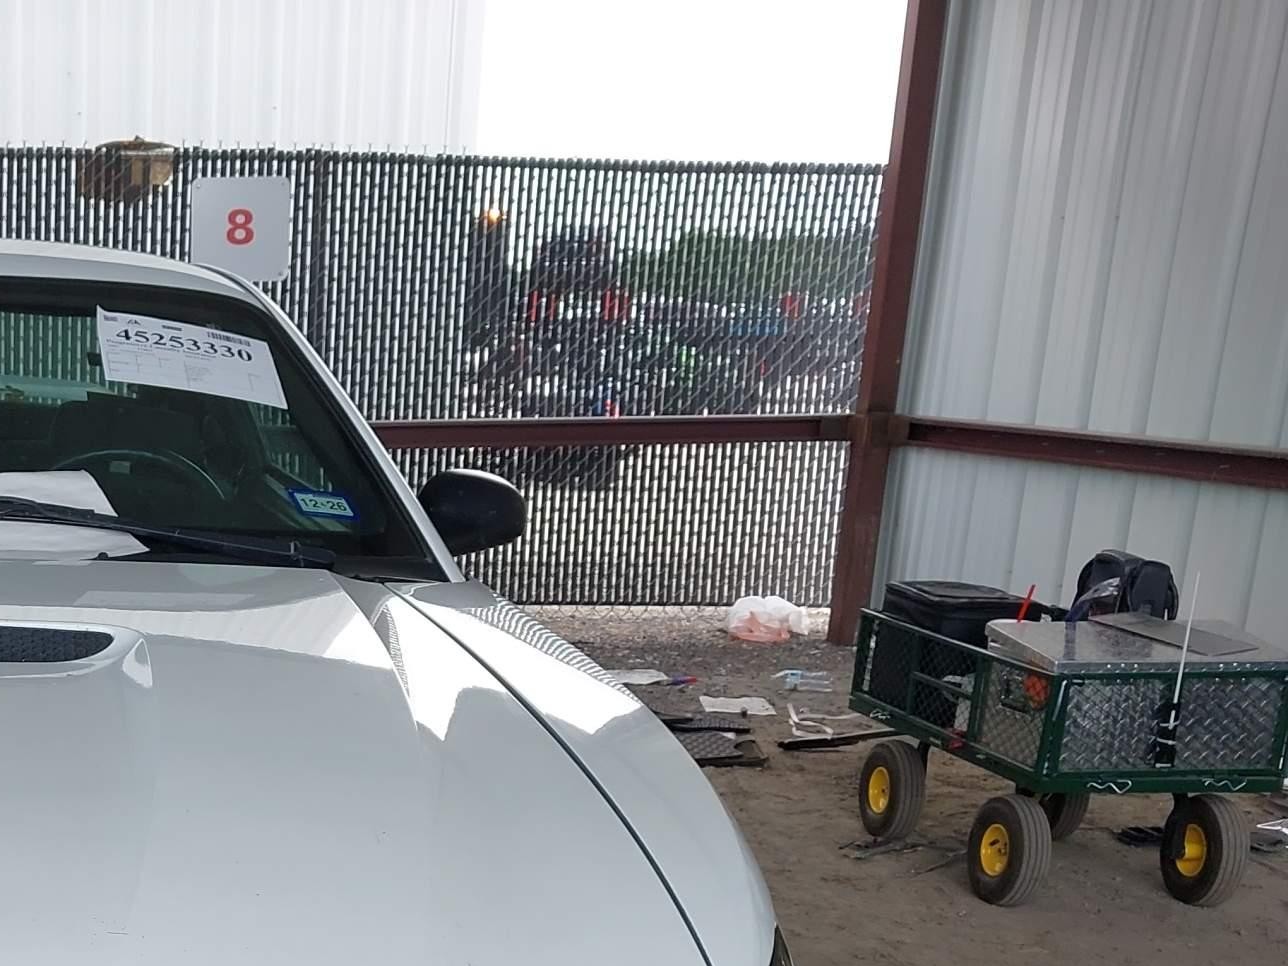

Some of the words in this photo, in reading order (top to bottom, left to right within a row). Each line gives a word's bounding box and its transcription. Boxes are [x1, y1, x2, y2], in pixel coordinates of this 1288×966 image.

[226, 208, 254, 245] 8
[115, 328, 253, 362] 45253330
[300, 498, 347, 511] 12-26
